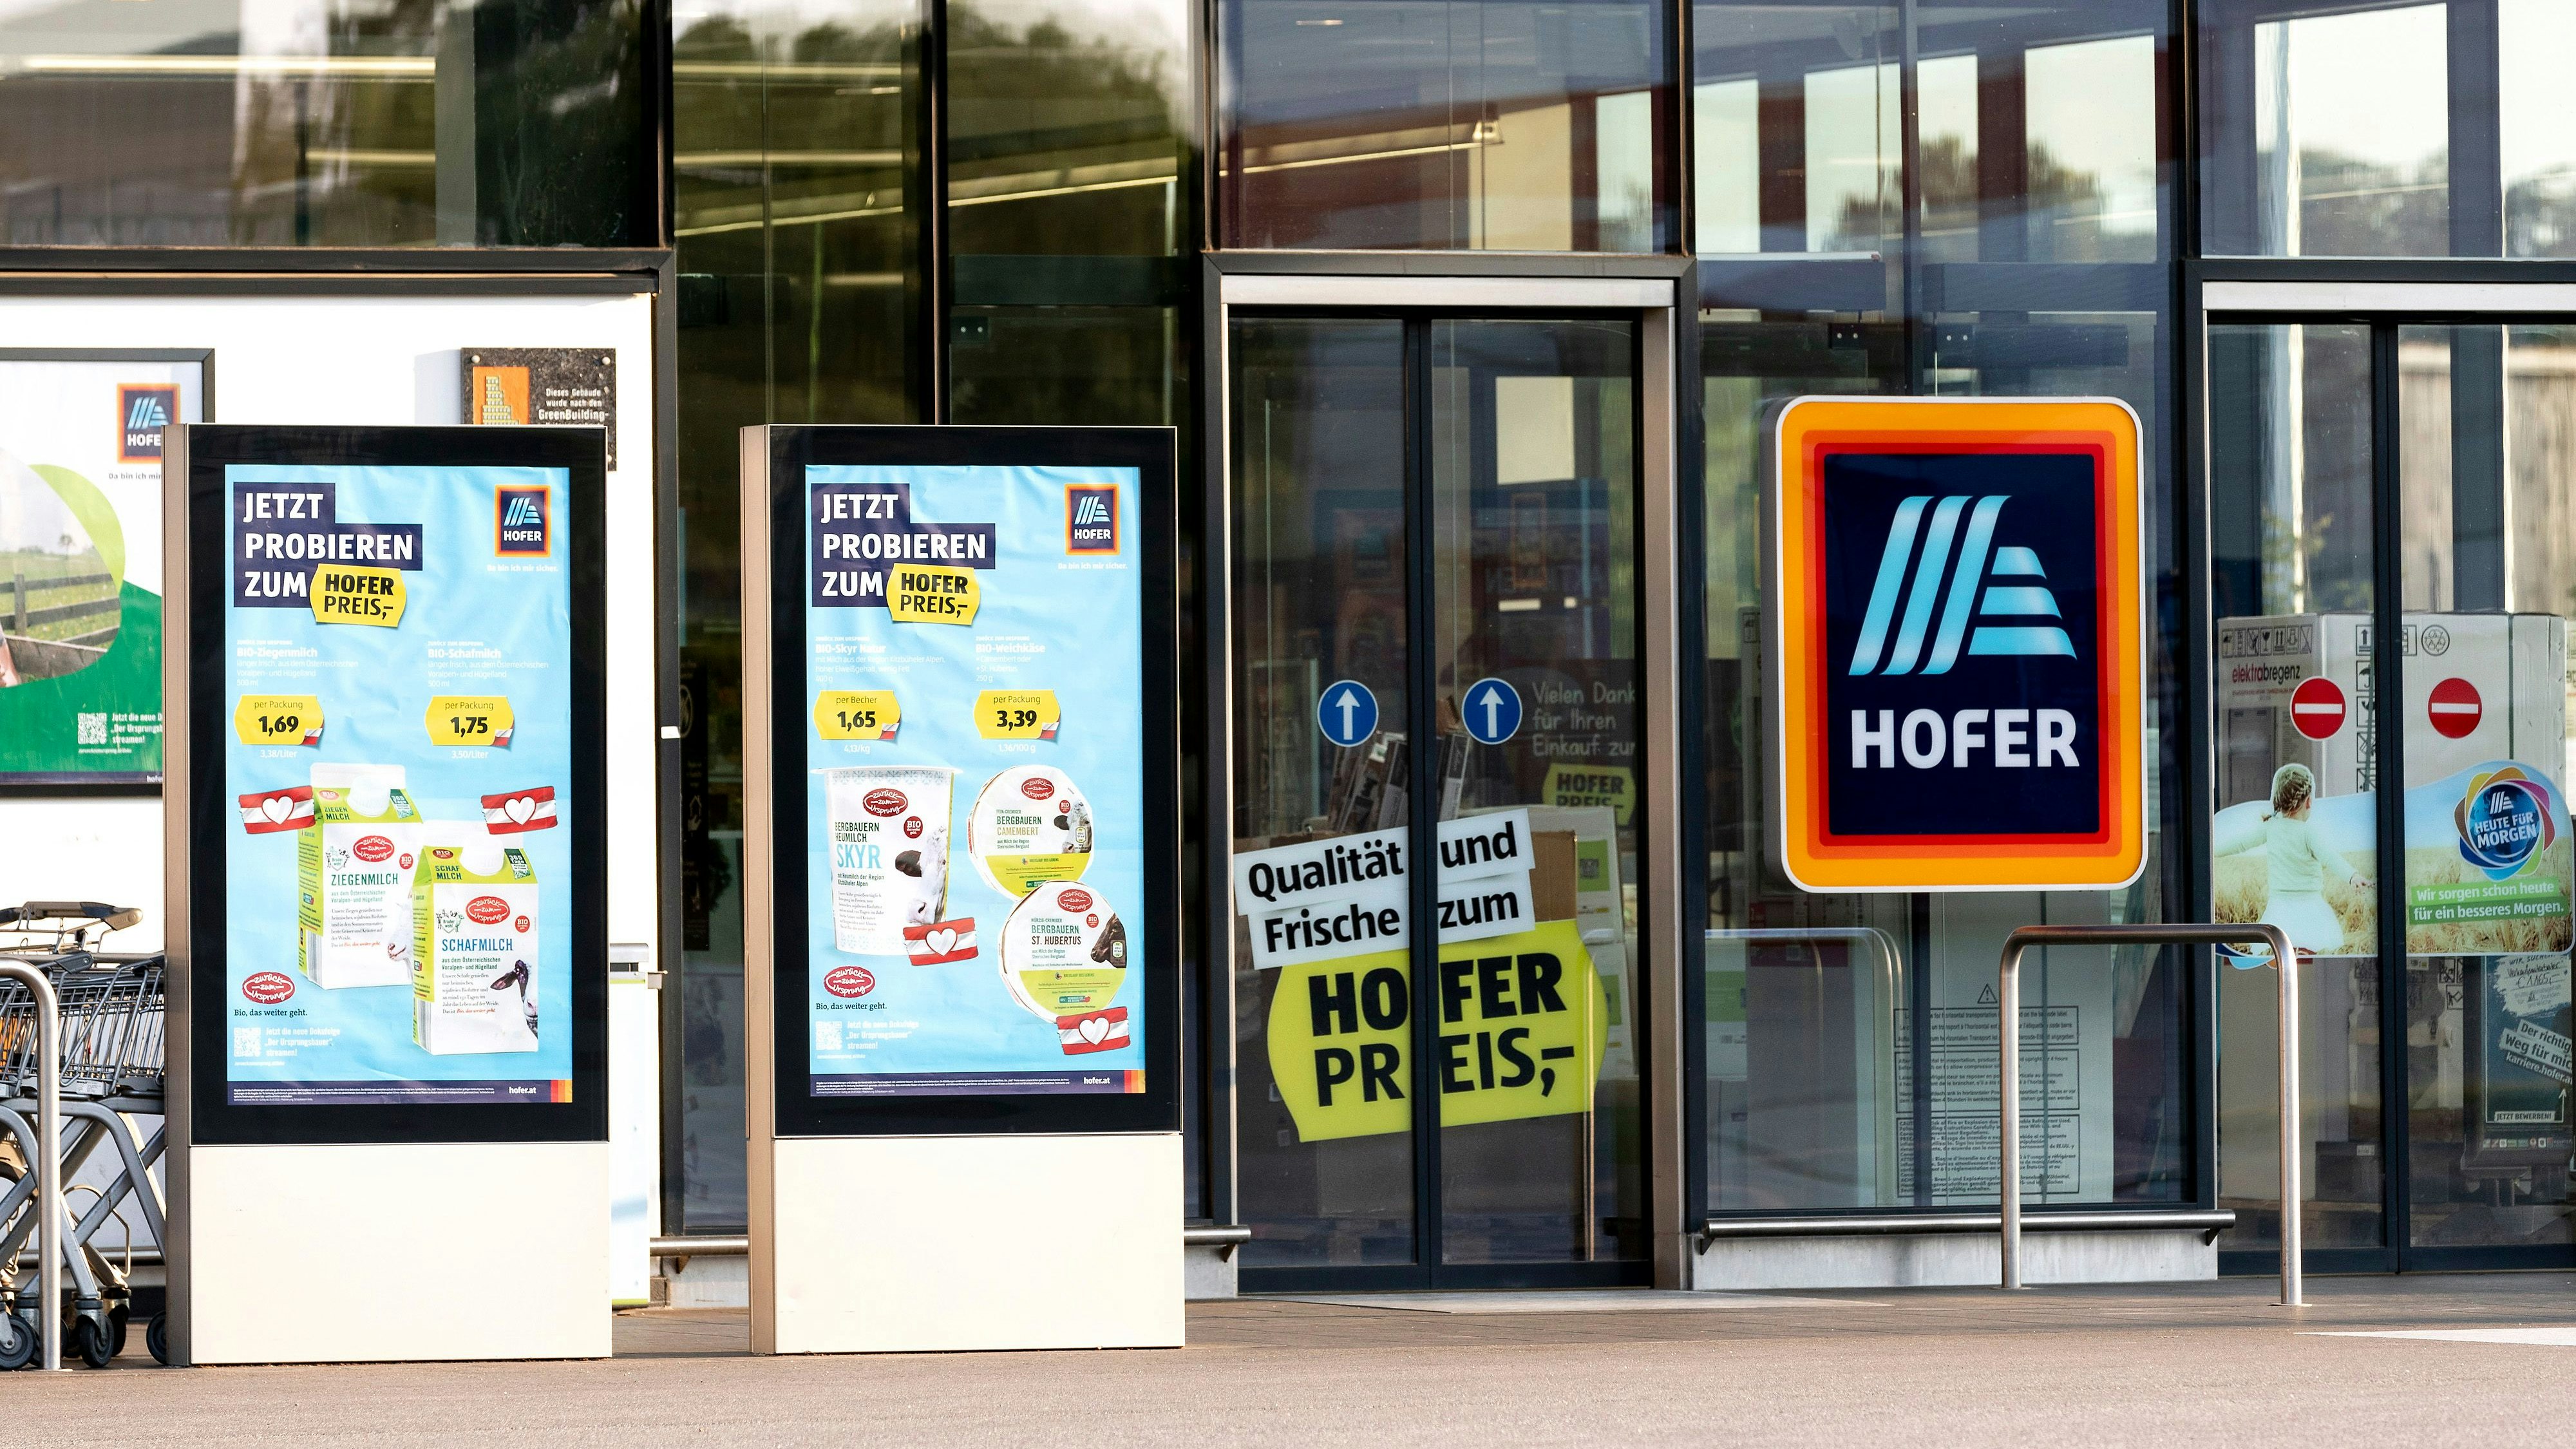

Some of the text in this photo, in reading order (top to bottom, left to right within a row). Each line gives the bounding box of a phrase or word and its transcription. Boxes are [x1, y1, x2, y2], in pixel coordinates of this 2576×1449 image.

[546, 388, 601, 397] Dieses Gebäude
[538, 409, 609, 422] GreenBuilding-
[127, 433, 161, 446] HOFE
[243, 493, 324, 523] JETZT
[820, 493, 899, 524] JETZT
[504, 530, 542, 542] HOFER
[1074, 529, 1111, 540] HOFER
[245, 533, 413, 560] PROBIEREN
[822, 533, 986, 559] PROBIEREN
[244, 571, 307, 598] ZUM
[325, 574, 394, 596] HOFER
[822, 571, 884, 597] ZUM
[901, 573, 968, 594] HOFER
[324, 595, 393, 620] PREIS,-
[900, 594, 968, 618] PREIS,-
[237, 647, 317, 659] BIO-Ziegenmilch
[428, 649, 502, 658] BIO-Schafmilch
[815, 643, 857, 655] BIO-Skyr
[976, 643, 1046, 653] BIO-Weichkäse
[2231, 663, 2301, 685] elektrabregenz
[1532, 681, 1635, 704] Vielen Dank
[254, 701, 303, 710] per Packung
[445, 701, 494, 711] per Packung
[836, 696, 877, 705] per Becher
[993, 696, 1041, 705] per Packung
[129, 713, 139, 721] die
[837, 711, 876, 732] 1,65
[996, 710, 1037, 732] 3,39
[1533, 708, 1617, 730] für Ihren
[127, 723, 162, 734] Ursprungsb
[258, 715, 299, 737] 1,69
[450, 717, 488, 737] 1,75
[1852, 708, 2079, 769] HOFER
[844, 744, 870, 755] 4,13/kg
[1532, 734, 1602, 757] Einkauf
[260, 749, 298, 759] 3,38/Liter
[451, 750, 489, 759] 3,50/Liter
[1556, 773, 1624, 794] HOFER
[872, 790, 897, 799] zurück
[869, 804, 900, 816] Ursprung
[996, 816, 1042, 825] BERGBAUERN
[2474, 812, 2534, 833] HEUTE FÜR
[835, 822, 880, 832] BERGBAUERN
[997, 827, 1039, 836] CAMEMBERT
[363, 837, 385, 846] zurück
[835, 833, 867, 842] HEUMILCH
[2477, 824, 2537, 849] MORGEN
[360, 851, 387, 861] Ursprung
[837, 844, 882, 869] SKYR
[1248, 820, 1518, 902] Qualität und
[331, 873, 399, 886] ZIEGENMILCH
[1065, 890, 1085, 898] zurück
[2417, 882, 2555, 902] Wir sorgen schon heute
[475, 898, 500, 906] zurück
[1063, 902, 1086, 912] Ursprung
[474, 912, 502, 923] Ursprung
[2414, 902, 2564, 921] für ein besseres Morgen.
[1265, 891, 1519, 953] Frische zum
[1031, 925, 1079, 934] BERGBAUERN
[442, 938, 513, 951] SCHAFMILCH
[1032, 936, 1081, 945] ST. HUBERTUS
[835, 967, 864, 978] zurück
[253, 973, 283, 985] zurück
[251, 991, 285, 1003] Ursprung
[833, 985, 866, 997] Ursprung
[869, 1002, 887, 1011] geht.
[289, 1009, 308, 1018] geht.
[2521, 1022, 2539, 1037] Der
[2505, 1034, 2572, 1070] Weg für mic
[1083, 1076, 1111, 1084] hofer.at
[509, 1086, 536, 1095] hofer.at
